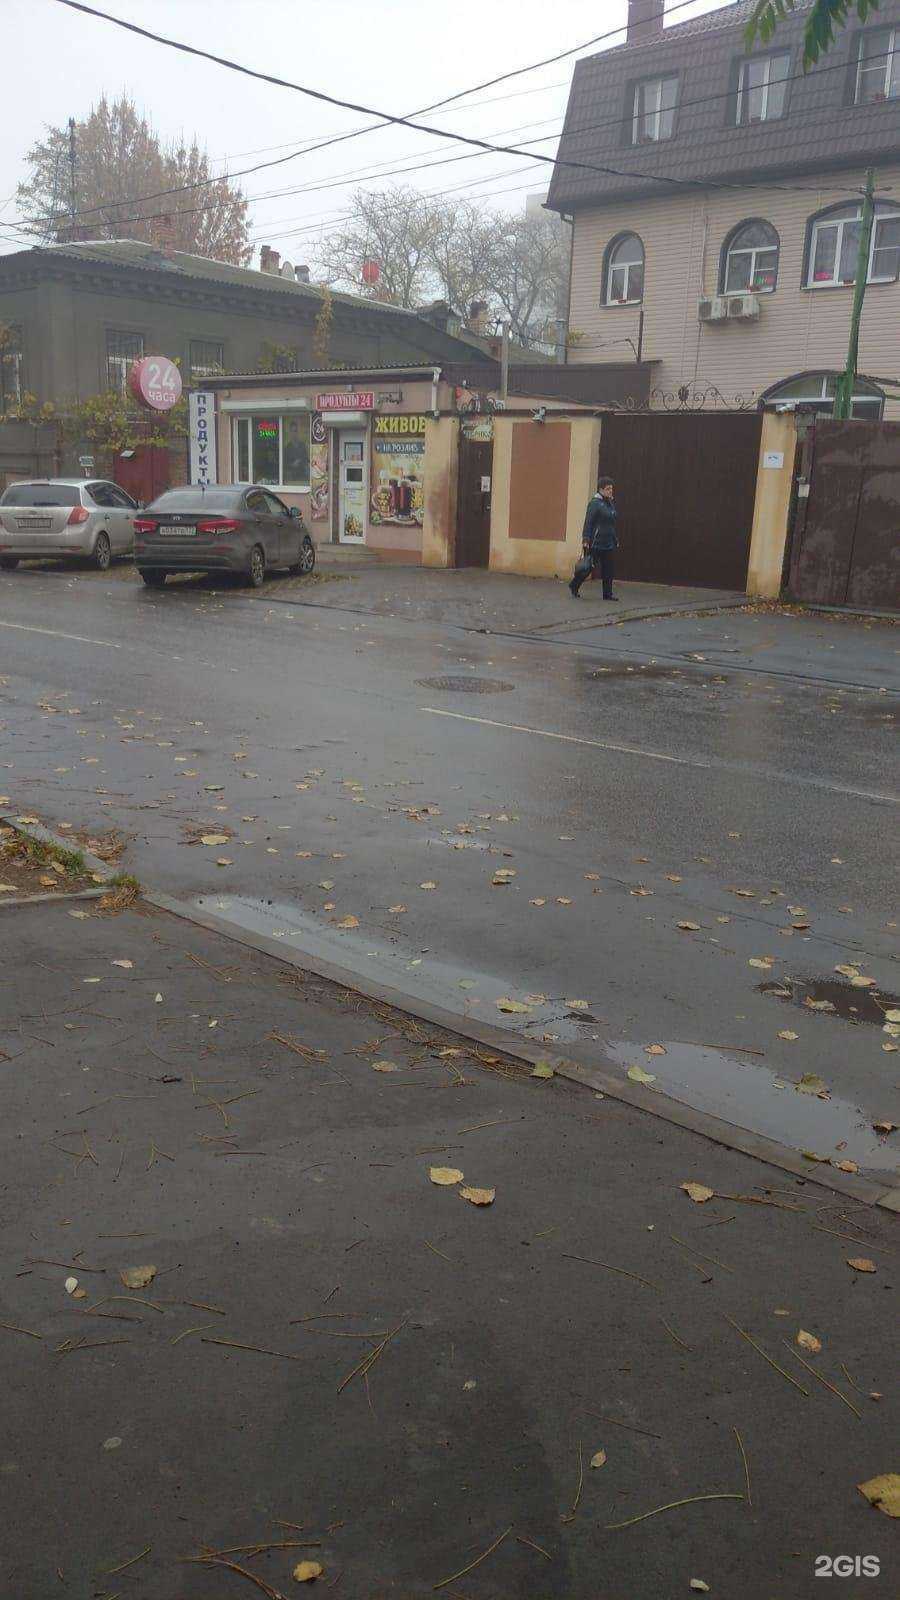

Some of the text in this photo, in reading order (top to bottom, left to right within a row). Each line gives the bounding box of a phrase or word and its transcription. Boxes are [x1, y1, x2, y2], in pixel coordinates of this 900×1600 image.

[148, 363, 176, 391] 24
[319, 394, 371, 408] ПРОДУКТЫ 24
